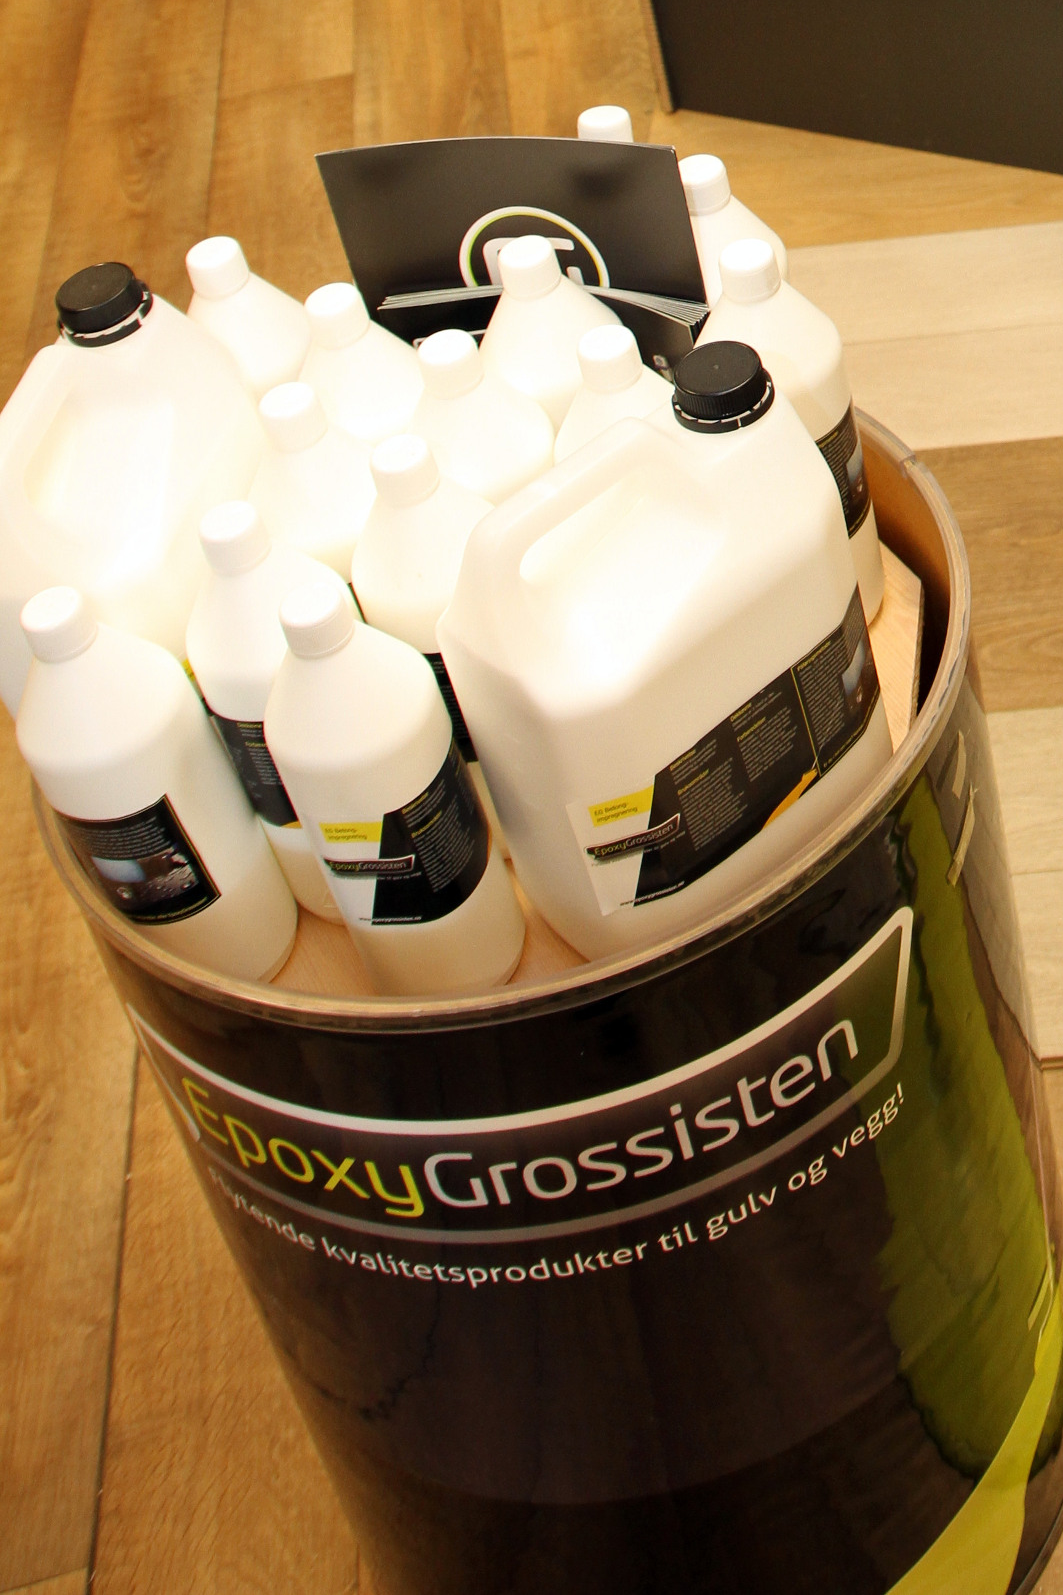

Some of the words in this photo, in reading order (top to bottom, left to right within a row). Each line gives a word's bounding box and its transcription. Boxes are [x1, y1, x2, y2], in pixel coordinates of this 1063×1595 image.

[594, 823, 674, 857] EpoxyGrossisten
[182, 1019, 859, 1218] EpoxyGrossisten
[207, 1166, 316, 1252] Flytende
[321, 1236, 648, 1288] kvalitetsprodukter
[657, 1221, 698, 1253] til
[705, 1185, 777, 1241] gulv
[787, 1155, 828, 1192] og
[831, 1083, 905, 1158] vegg!
